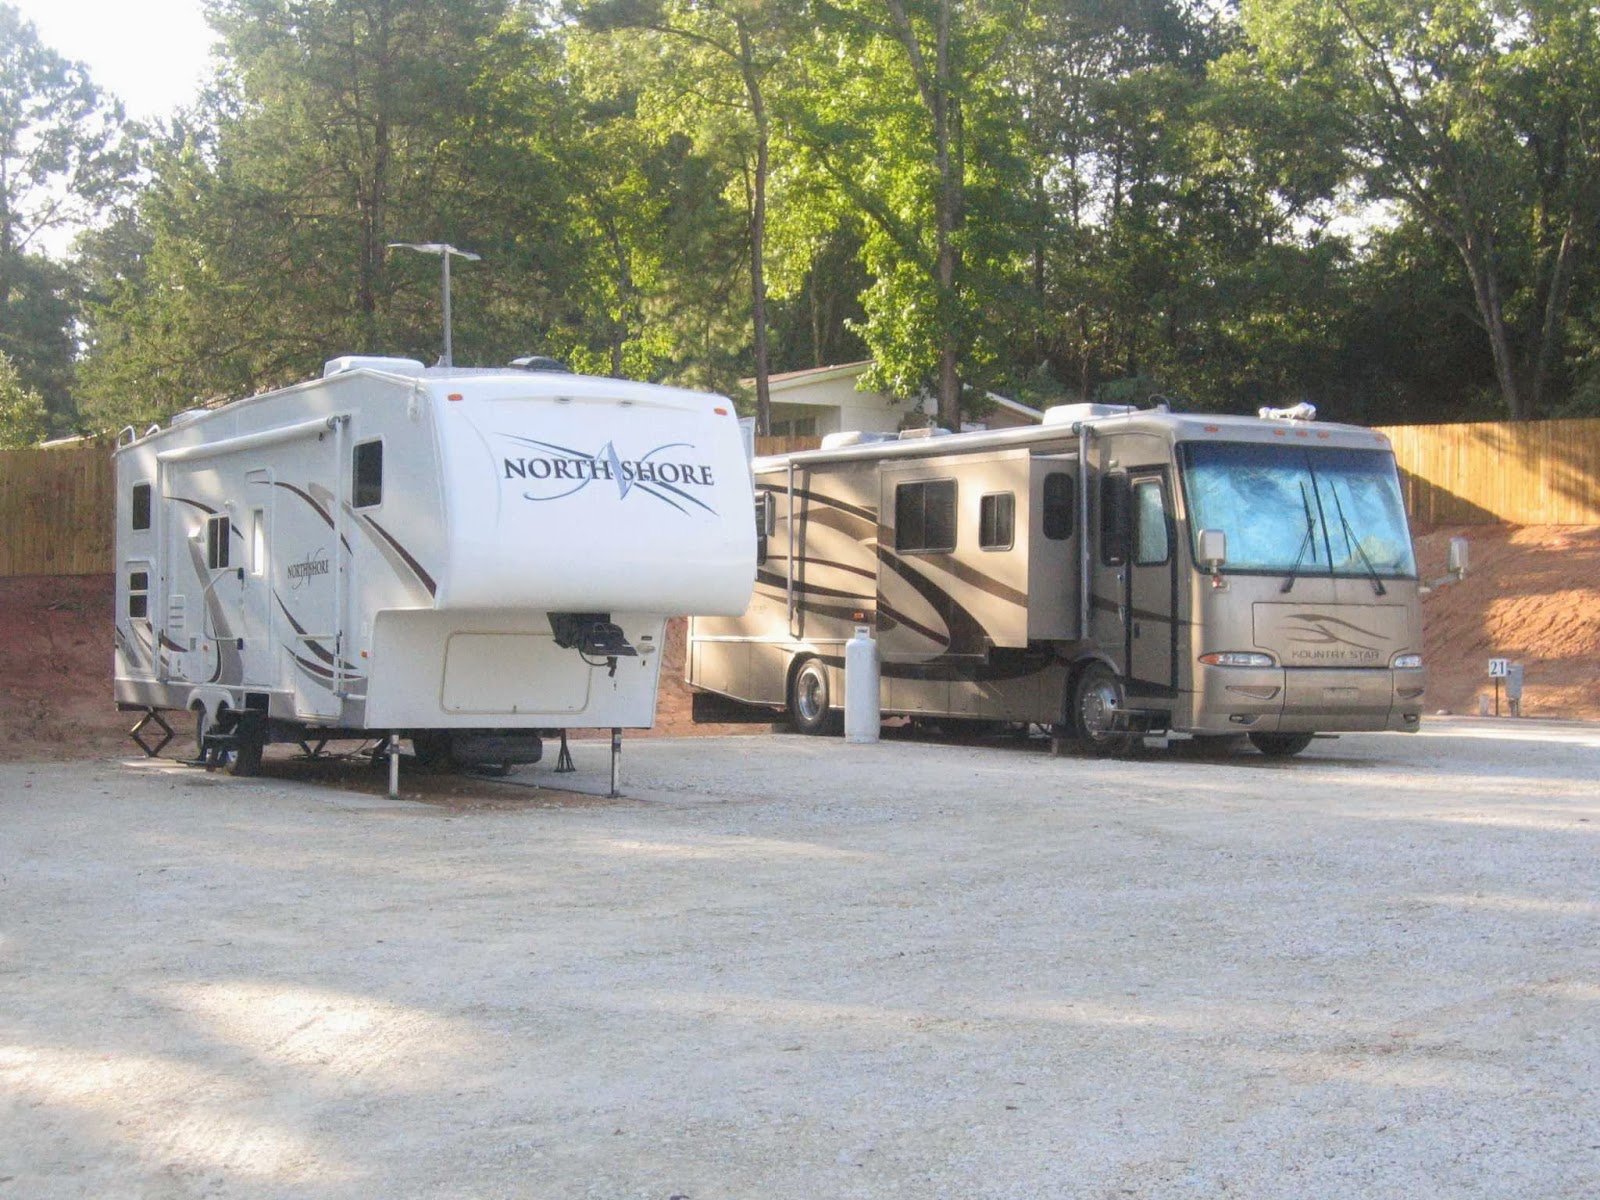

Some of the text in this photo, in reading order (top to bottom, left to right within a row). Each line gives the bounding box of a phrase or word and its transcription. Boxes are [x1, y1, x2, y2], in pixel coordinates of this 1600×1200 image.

[503, 457, 715, 486] NORTH SHORE
[1291, 650, 1380, 660] KOUNTRY STAR
[1490, 660, 1504, 675] 21
